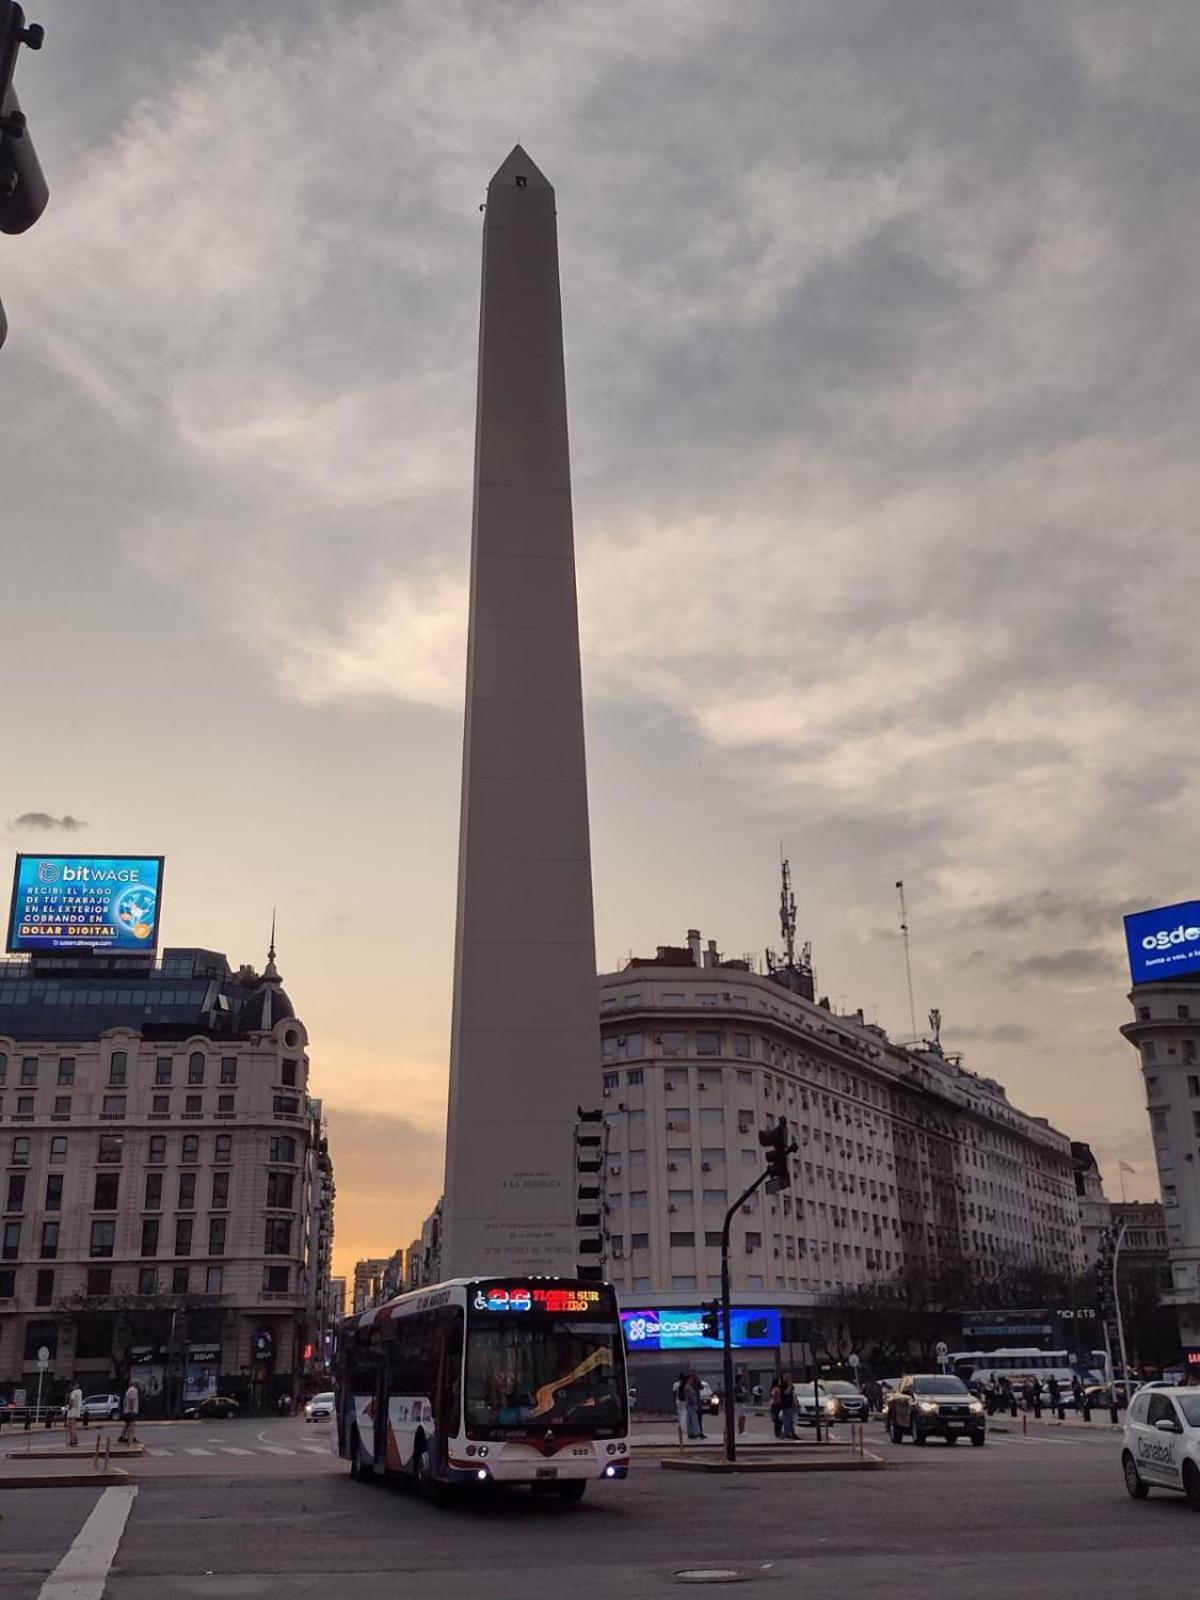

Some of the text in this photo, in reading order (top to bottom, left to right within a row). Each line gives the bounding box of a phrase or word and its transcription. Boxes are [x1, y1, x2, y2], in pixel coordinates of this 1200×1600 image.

[67, 887, 77, 895] EL
[82, 887, 112, 895] PAGO
[26, 896, 111, 904] DE TU TRABAJO
[25, 905, 109, 913] EN EL EXTERIOR
[24, 914, 103, 923] COBRANDO EN
[21, 926, 116, 935] DOLAR DIGITAL
[577, 1290, 599, 1301] SUR
[193, 1353, 215, 1361] BBVA
